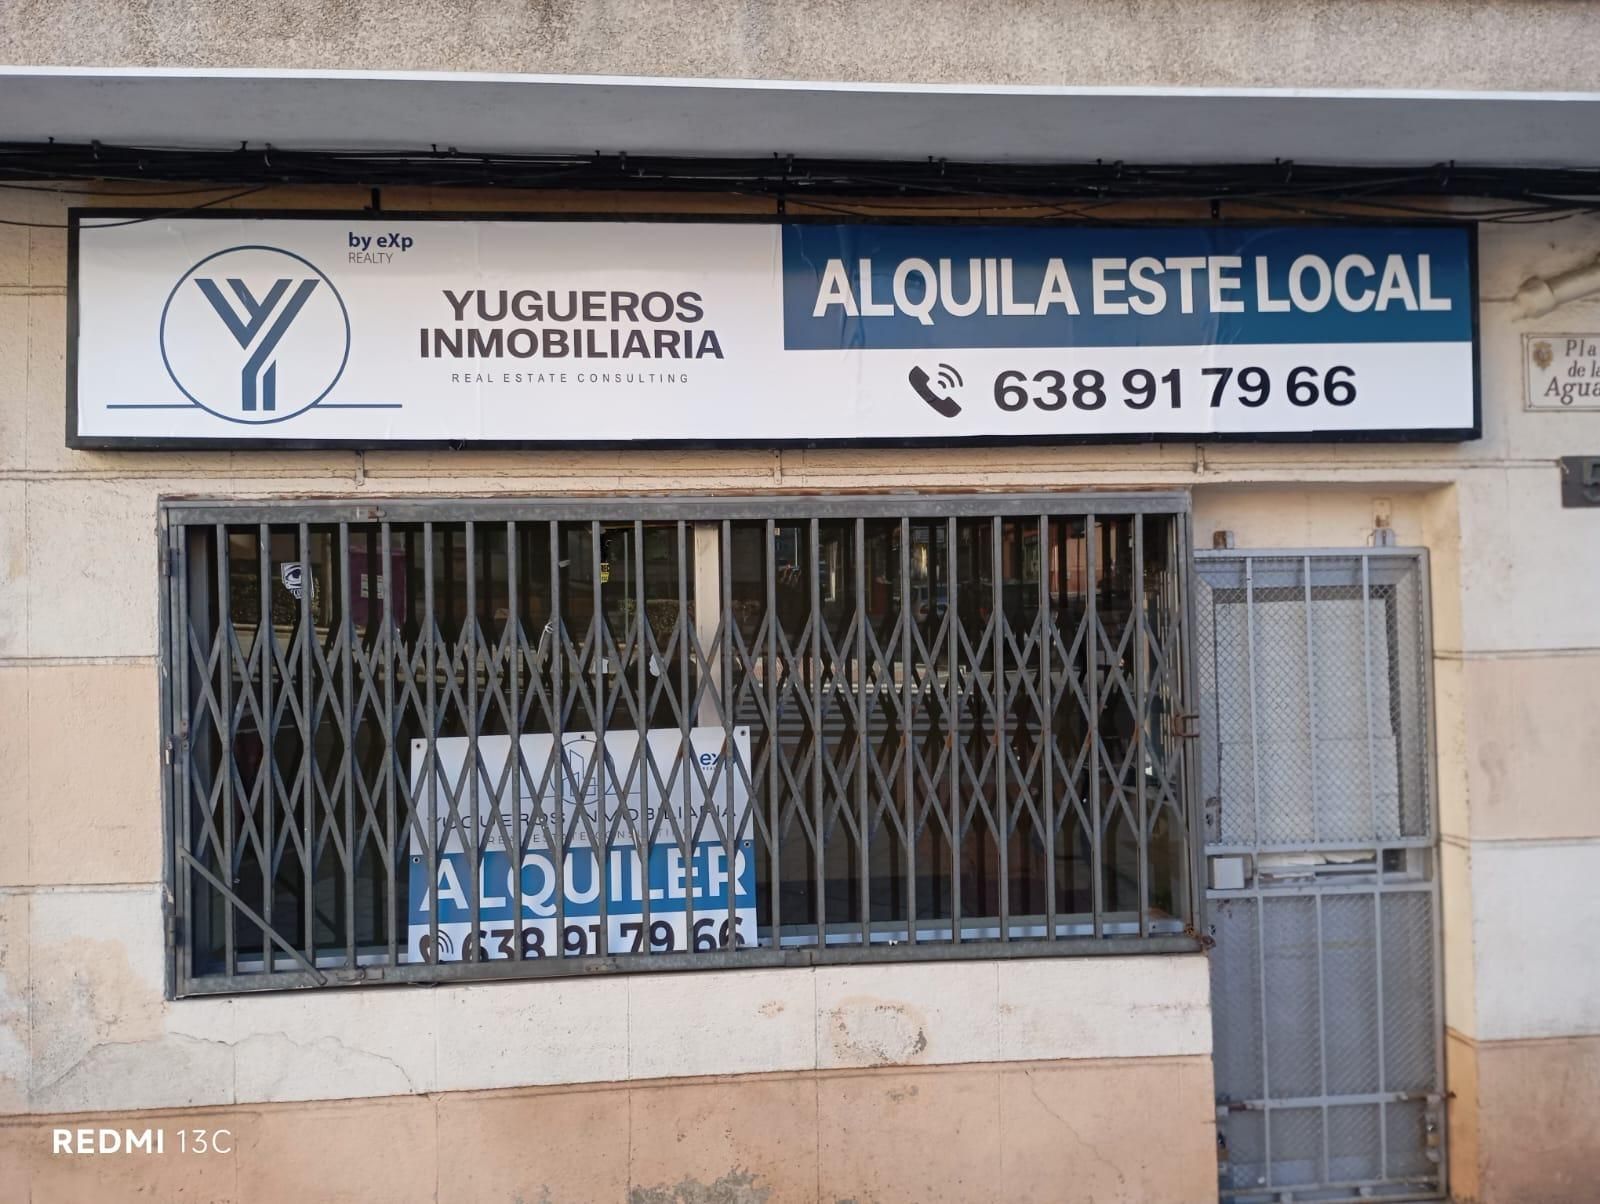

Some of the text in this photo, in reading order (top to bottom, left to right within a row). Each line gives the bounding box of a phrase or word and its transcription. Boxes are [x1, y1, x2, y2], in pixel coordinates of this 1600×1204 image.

[348, 231, 414, 252] by eXp
[348, 252, 394, 264] REALTY
[812, 253, 1452, 325] ALQUILA ESTE LOCAL
[442, 289, 705, 323] YUGUEROS
[419, 328, 725, 360] INMOBILIARIA
[452, 373, 689, 384] REAL ESTATE CONSULTING
[1568, 360, 1586, 377] de
[993, 365, 1357, 412] 638 91 79 66
[418, 846, 748, 917] ALQUILER
[461, 926, 546, 961] 638
[619, 920, 675, 953] 79
[693, 916, 746, 953] 66
